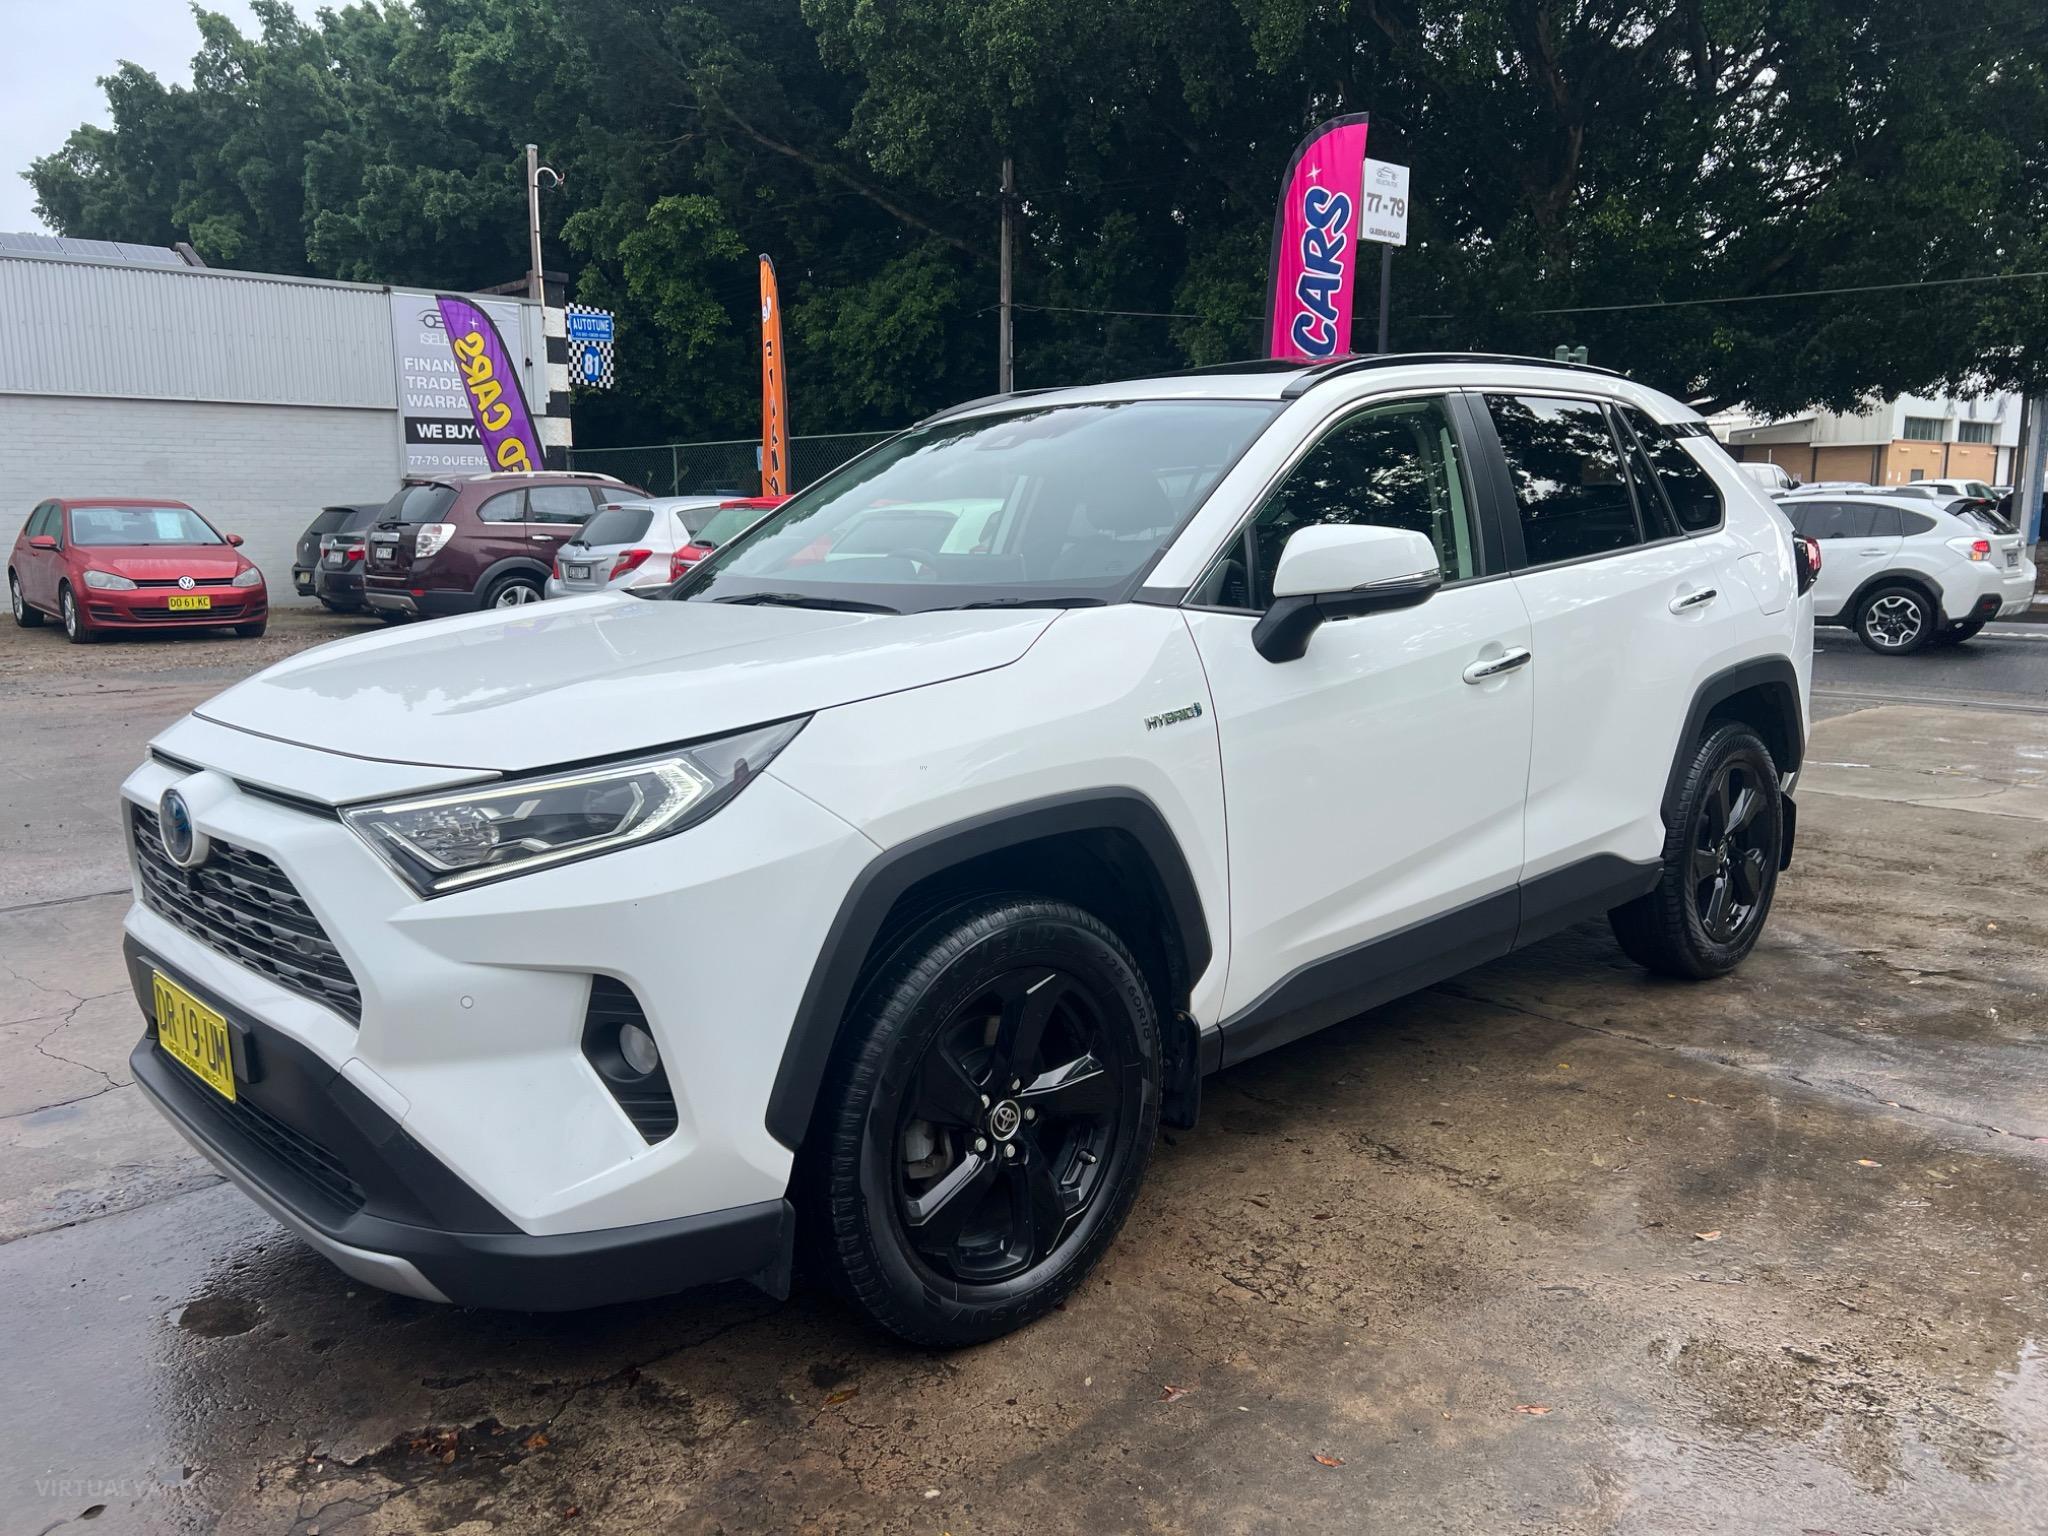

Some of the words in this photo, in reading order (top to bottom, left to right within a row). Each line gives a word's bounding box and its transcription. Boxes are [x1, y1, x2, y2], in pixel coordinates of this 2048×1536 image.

[1291, 186, 1352, 356] CARS
[573, 317, 610, 331] AUTOTUNE
[584, 353, 599, 376] 81
[405, 375, 462, 391] TRADE
[407, 394, 468, 409] WARRA
[416, 423, 443, 438] WE
[445, 424, 476, 439] BUY
[408, 455, 440, 466] 77-79
[1144, 706, 1195, 731] HYBRID
